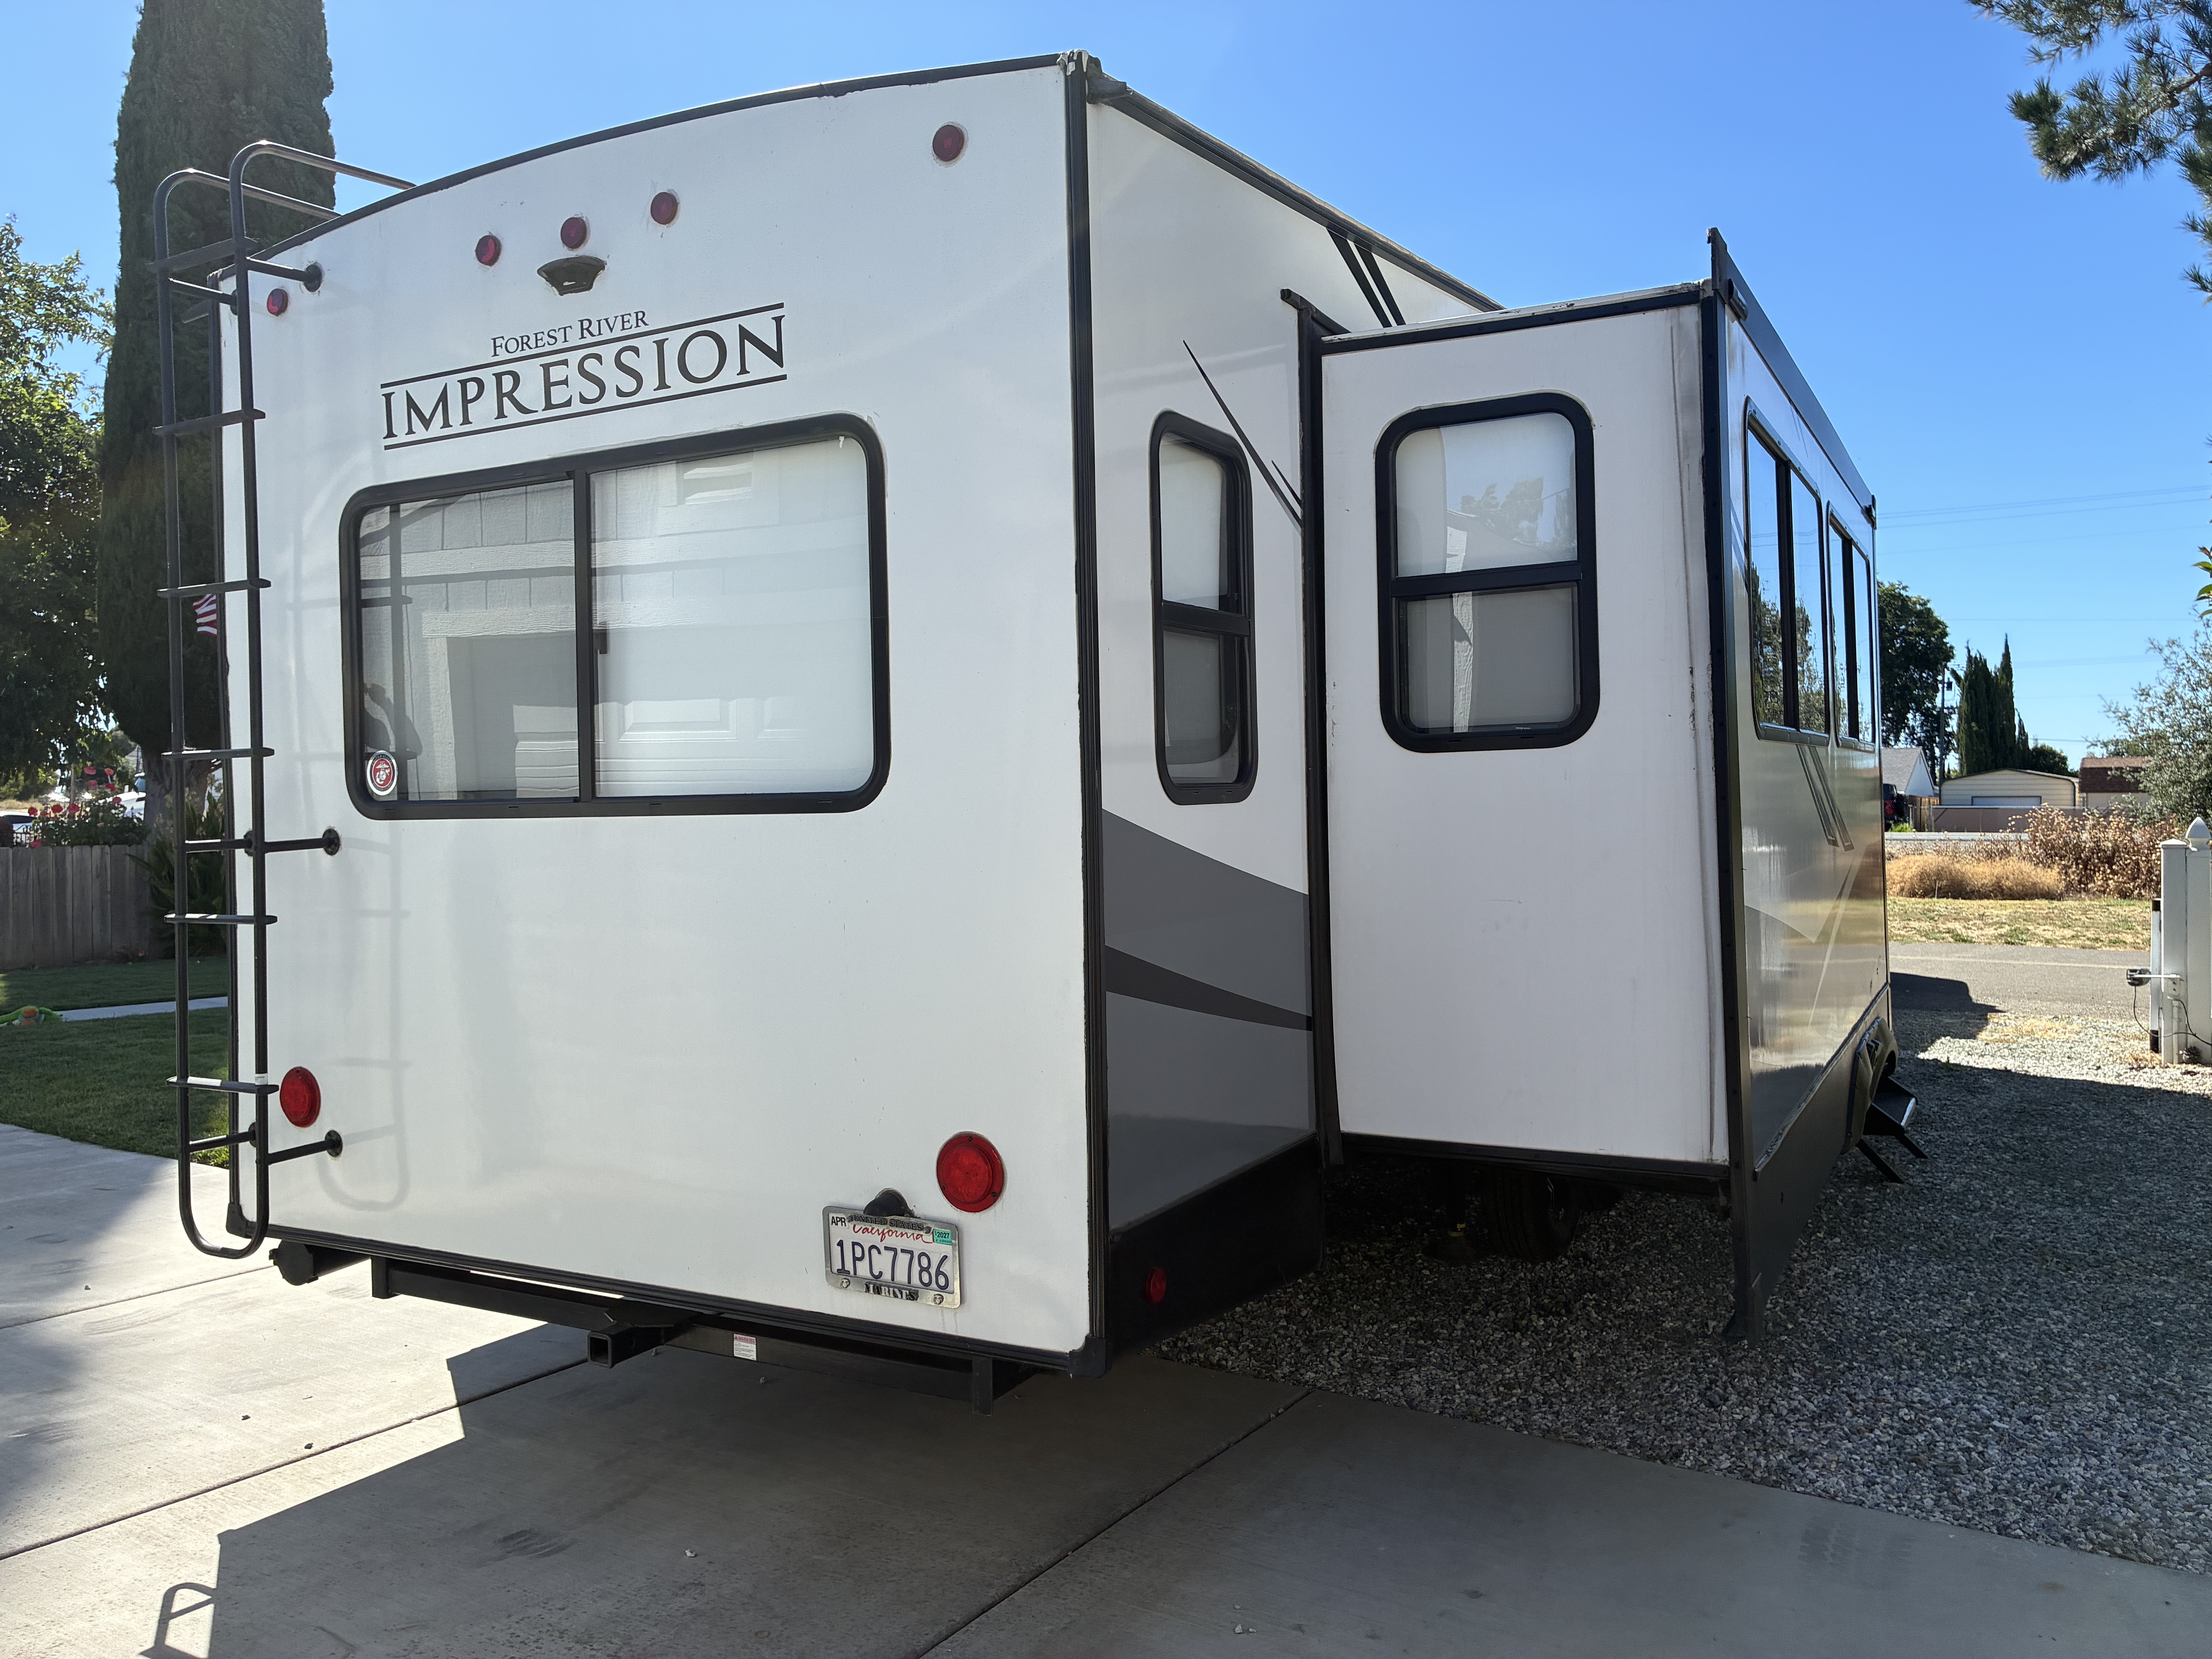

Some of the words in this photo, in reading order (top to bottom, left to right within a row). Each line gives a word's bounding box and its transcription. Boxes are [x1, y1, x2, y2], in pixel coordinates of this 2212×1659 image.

[491, 325, 573, 357] FOREST
[578, 310, 649, 341] RIVER
[381, 314, 786, 440] IMPRESSION
[831, 1216, 847, 1227] APR
[854, 1215, 886, 1225] UNITED
[889, 1219, 924, 1231] STATES
[836, 1240, 949, 1290] 1PC7786
[864, 1283, 918, 1301] MARINES
